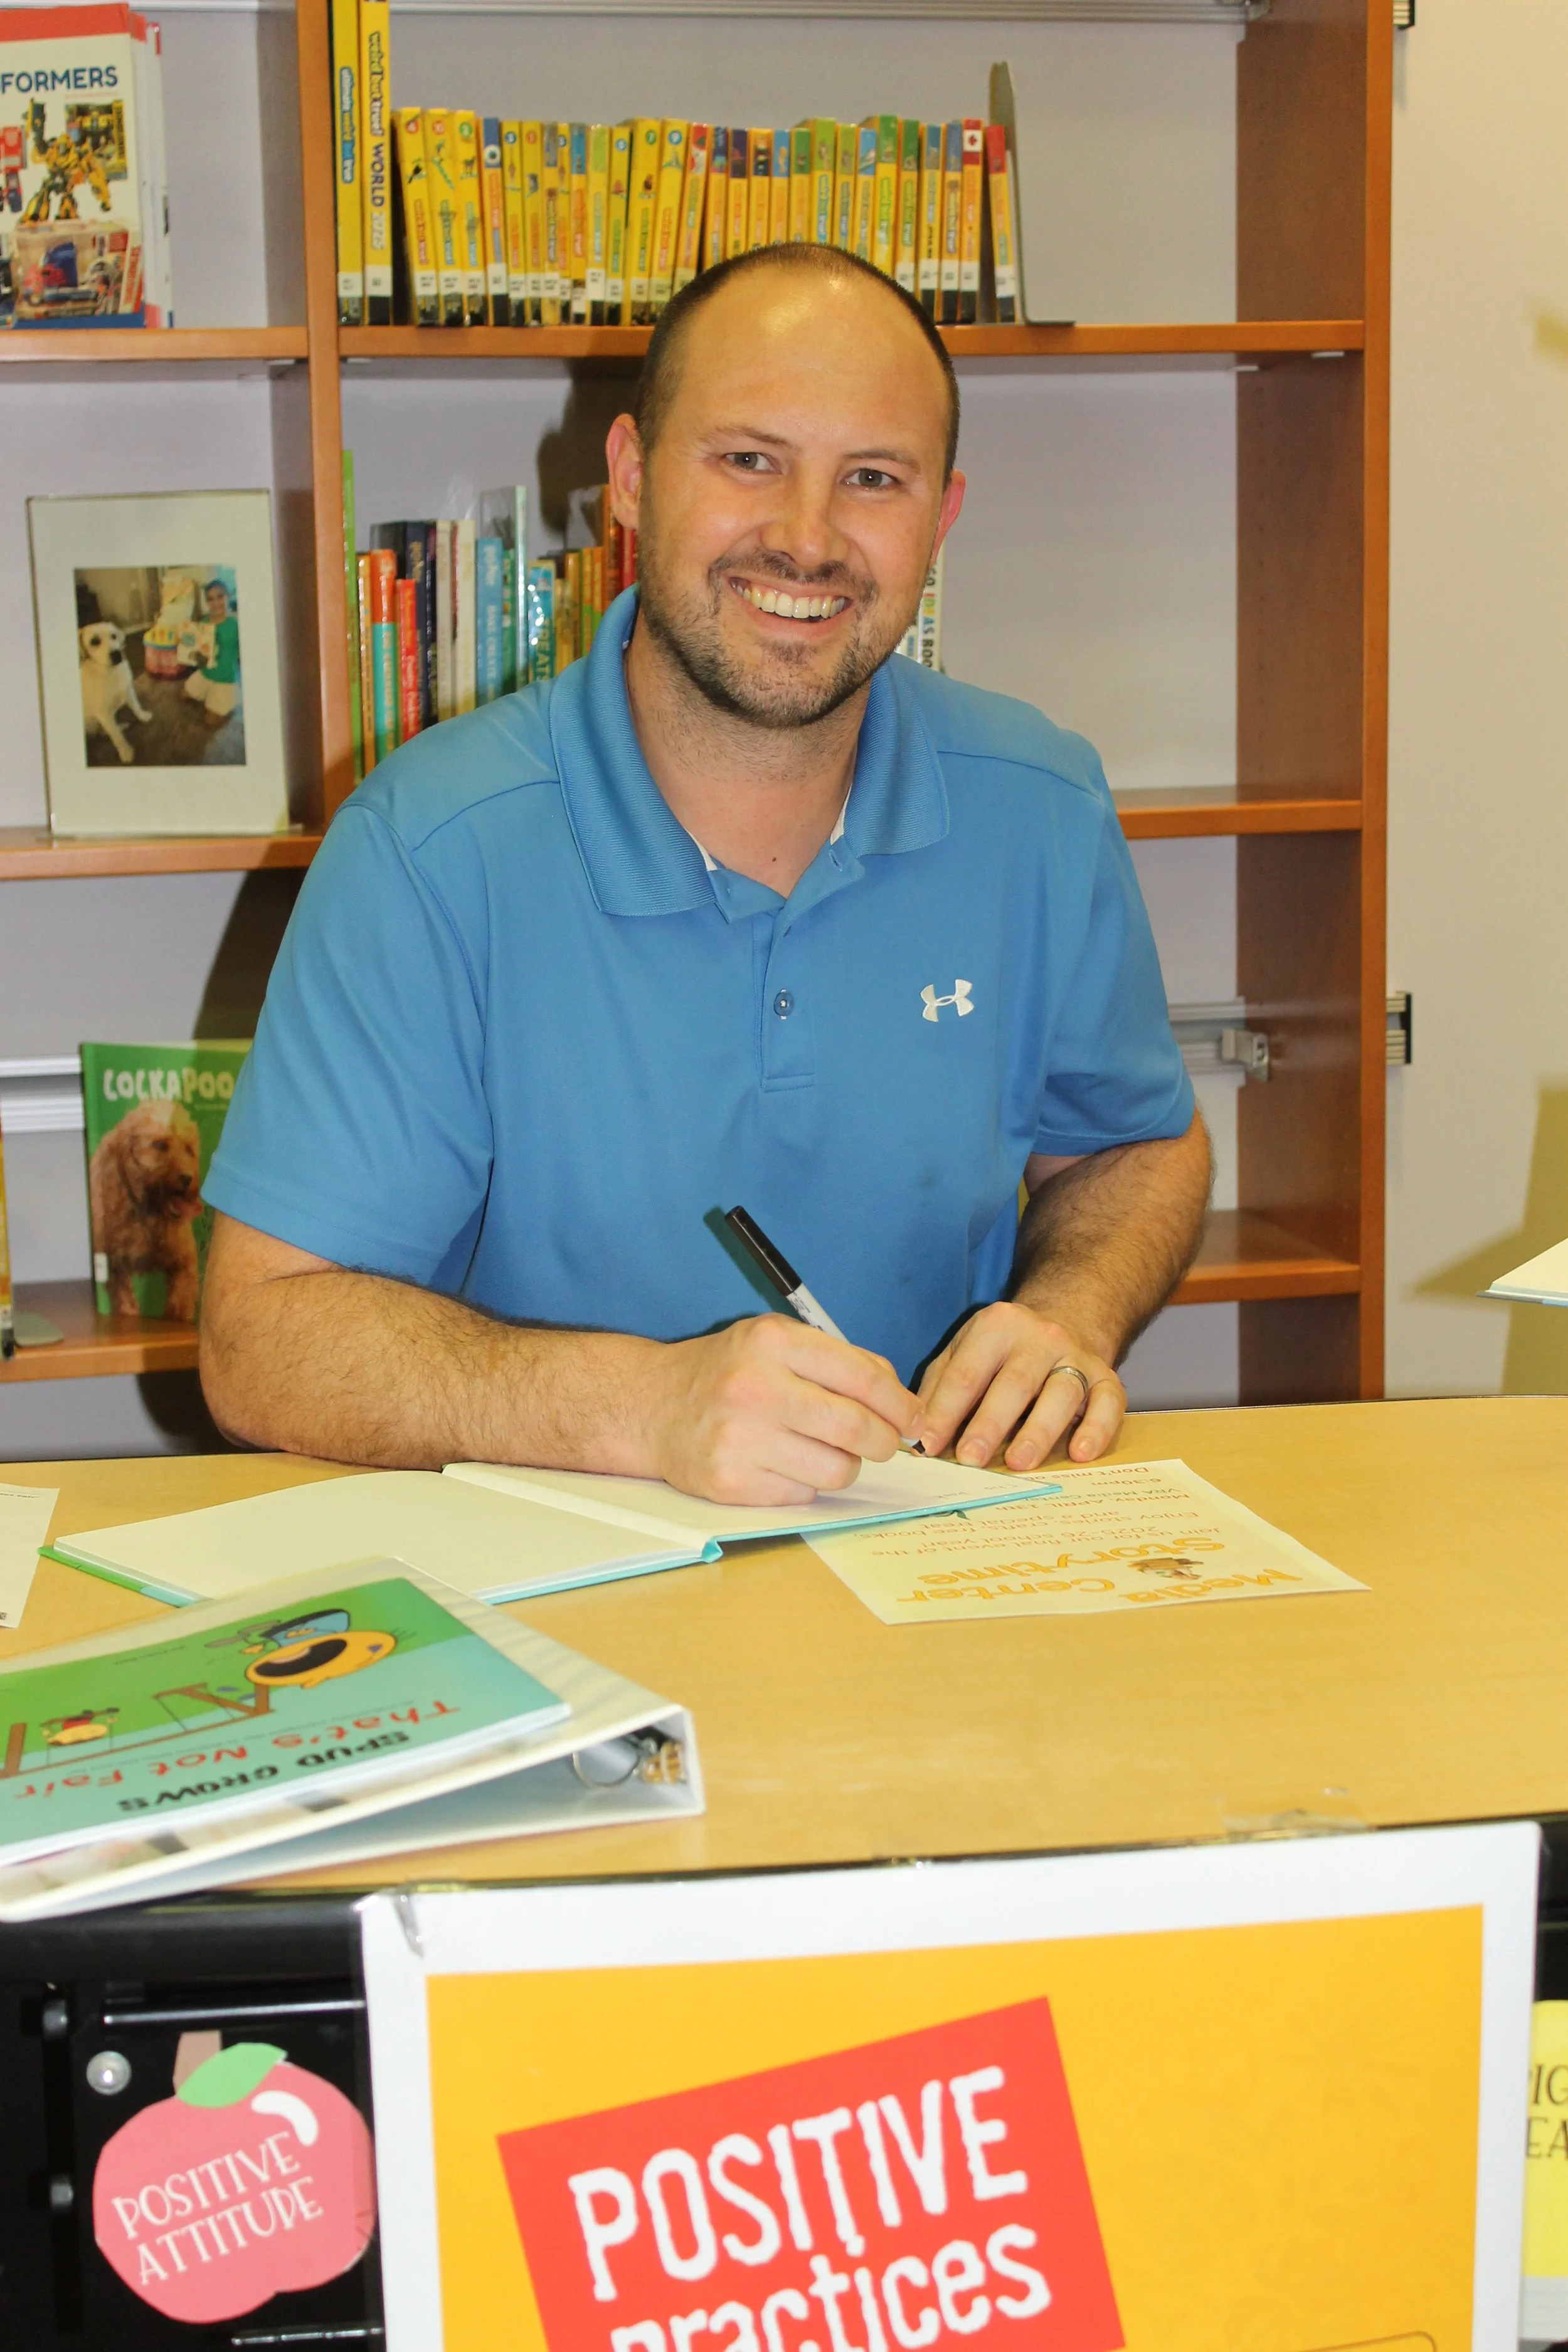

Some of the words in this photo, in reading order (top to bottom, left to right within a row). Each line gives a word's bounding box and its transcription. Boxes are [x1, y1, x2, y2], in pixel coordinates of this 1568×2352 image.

[1, 65, 119, 94] FORMERS
[371, 144, 385, 207] WORLD
[923, 593, 936, 635] IDEAS
[1097, 1467, 1149, 1476] Don't
[978, 1515, 1054, 1526] special
[1044, 1499, 1103, 1508] APRIL
[1080, 1511, 1119, 1519] and
[981, 1534, 1054, 1543] school
[918, 1536, 1225, 1586] Storytime
[897, 1577, 1116, 1603] Center
[1119, 1569, 1303, 1603] Media
[271, 1700, 460, 1751] That's
[147, 1744, 248, 1777] Not
[297, 1730, 410, 1767] SPUD
[13, 1769, 123, 1800] Fair
[117, 1766, 280, 1812] GROWS
[1528, 2063, 1568, 2106] IG
[111, 2131, 301, 2240] POSITIVE
[568, 2065, 1029, 2302] POSITIVE
[137, 2175, 324, 2286] ATTITUDE
